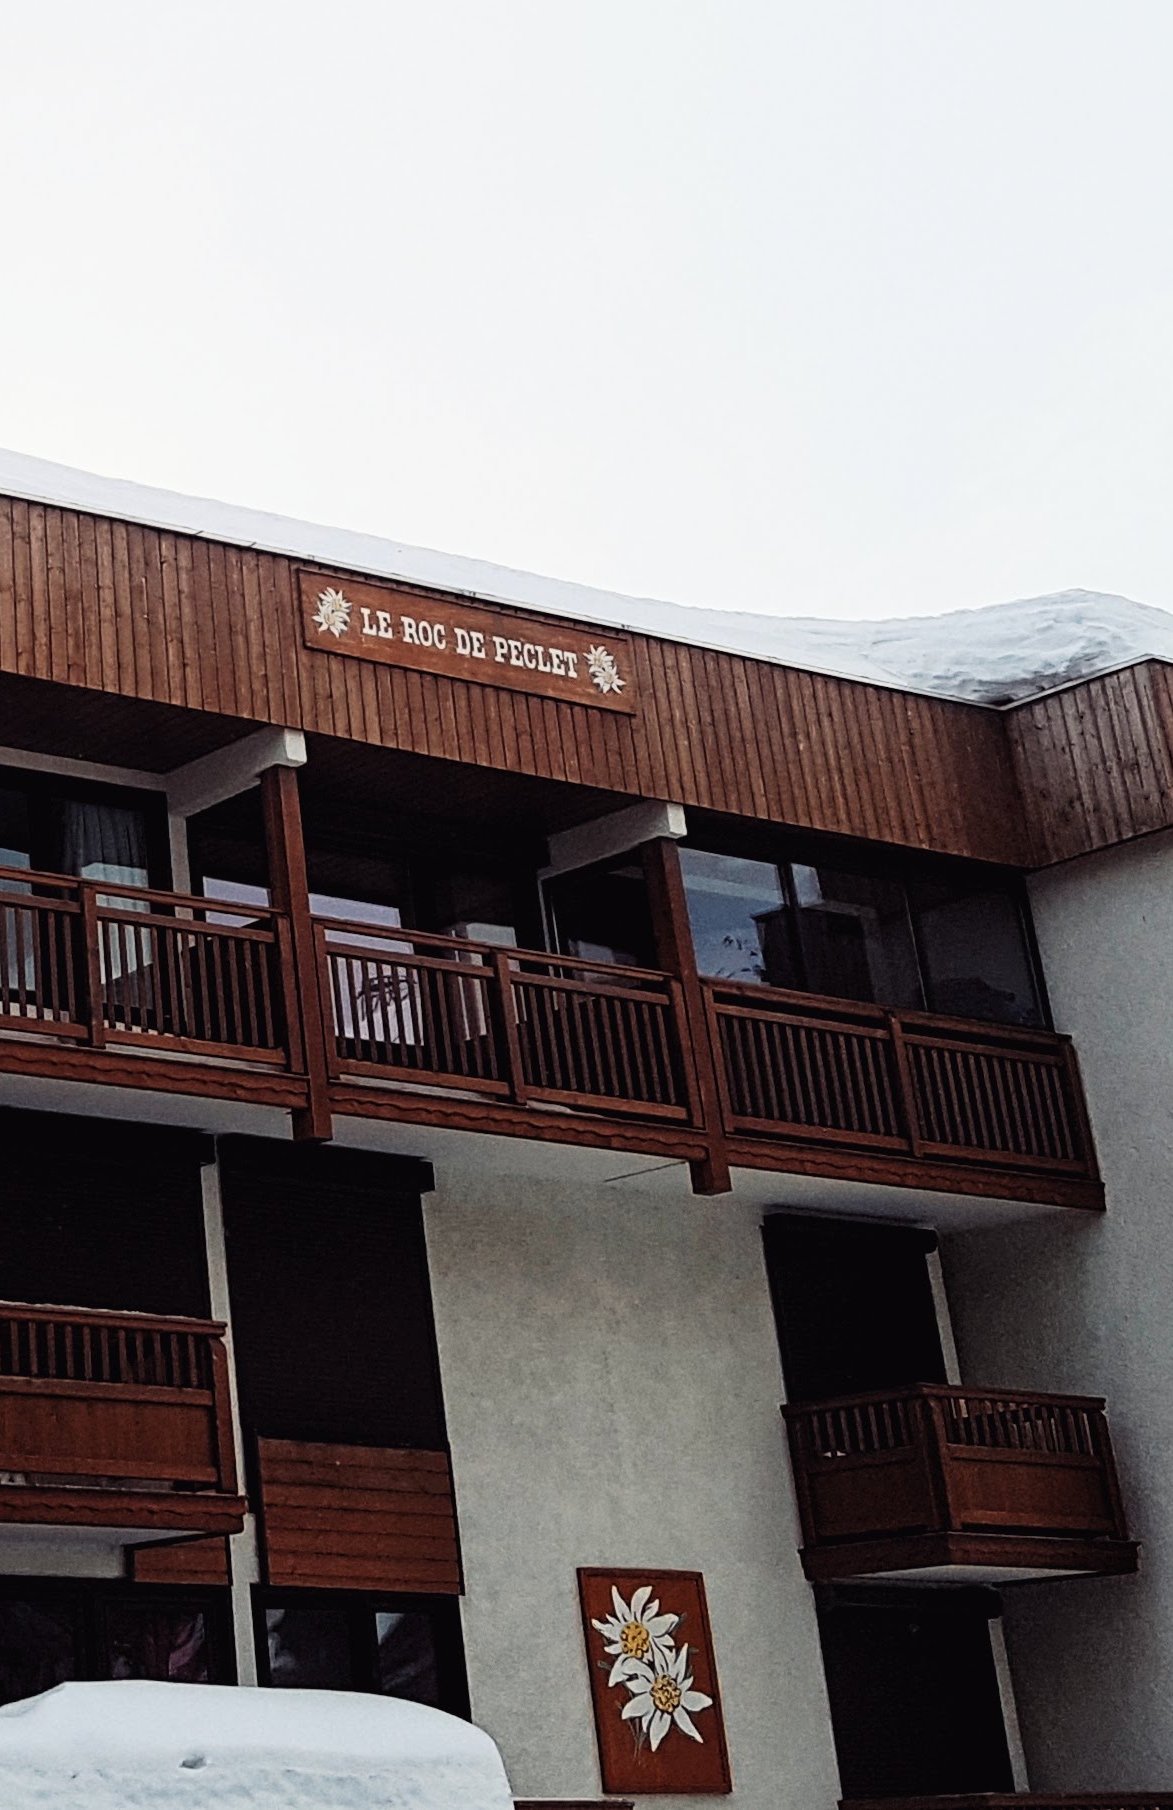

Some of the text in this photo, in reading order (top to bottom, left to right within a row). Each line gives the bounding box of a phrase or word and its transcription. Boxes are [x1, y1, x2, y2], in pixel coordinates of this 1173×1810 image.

[360, 607, 578, 679] LE ROC DE PECLET
